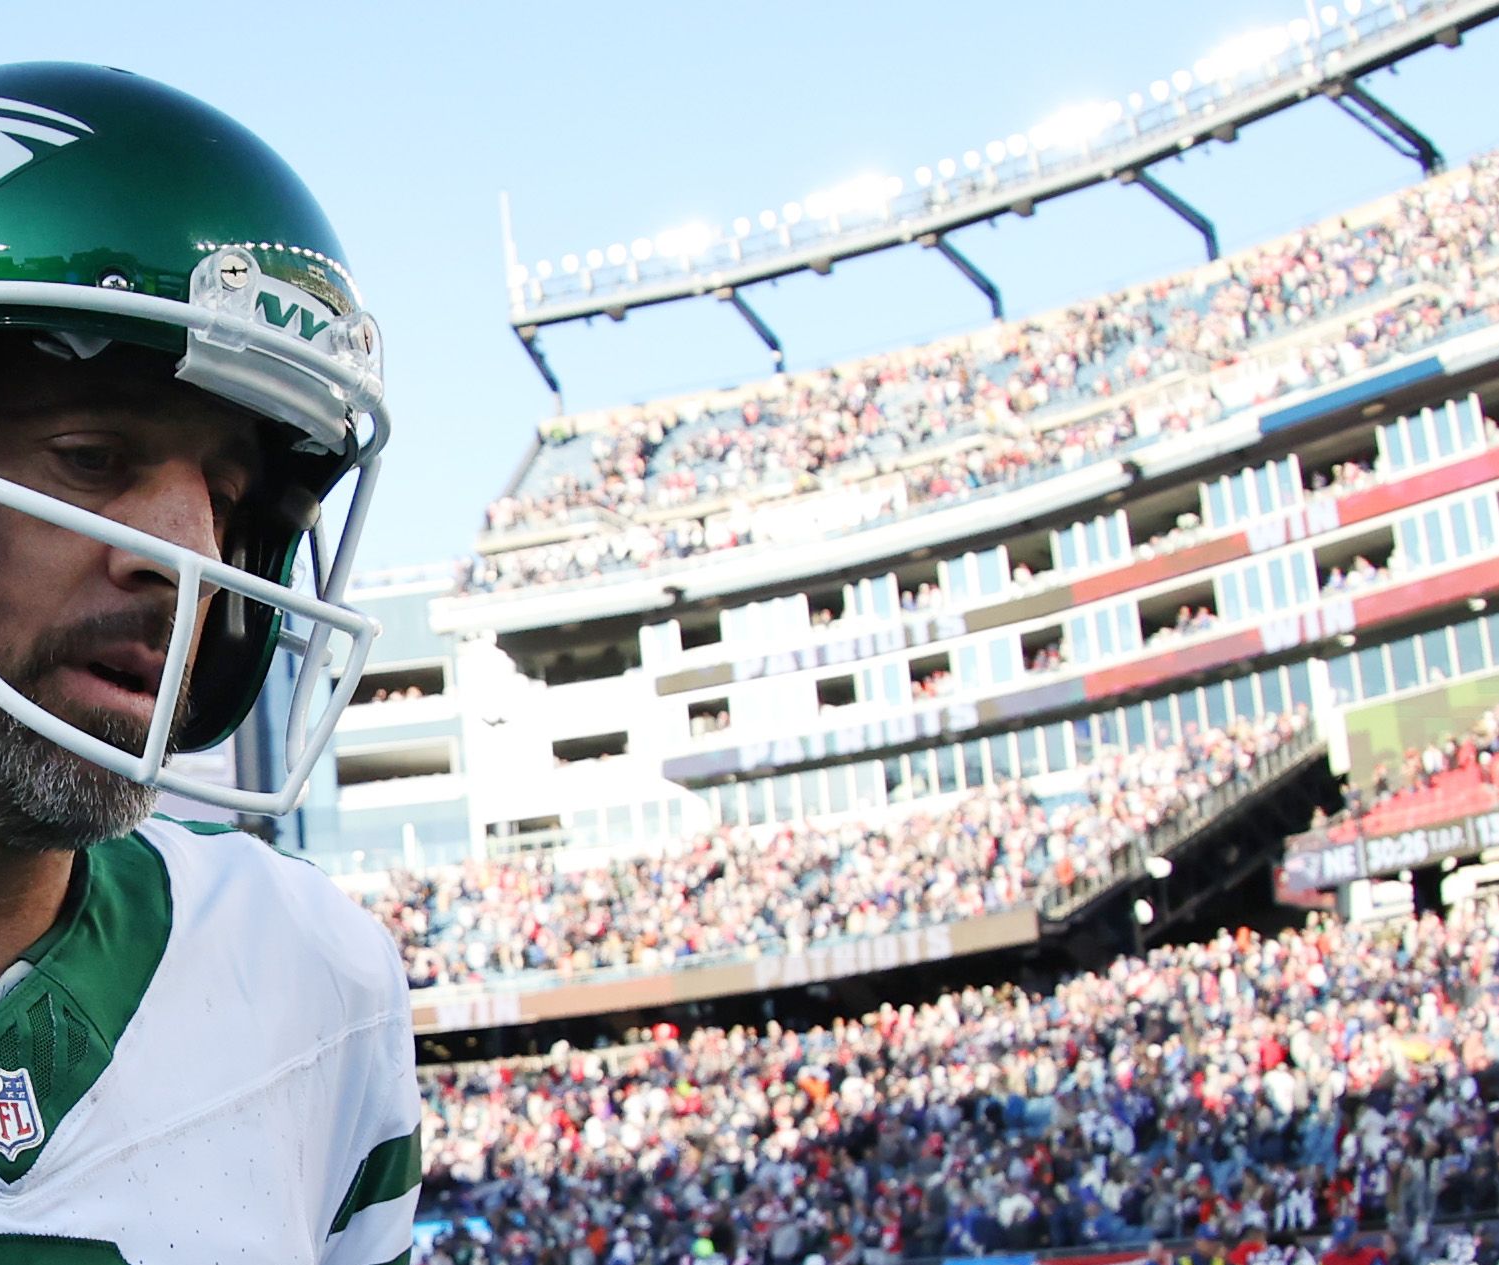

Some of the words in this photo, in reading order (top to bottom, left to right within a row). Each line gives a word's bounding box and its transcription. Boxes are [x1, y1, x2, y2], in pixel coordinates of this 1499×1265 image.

[255, 290, 331, 342] NY
[1249, 500, 1340, 554] WIN
[731, 613, 967, 682] PATRIOTS
[1262, 601, 1356, 654] WIN
[737, 703, 979, 771] PATRIOTS
[1322, 844, 1357, 879] NE
[752, 926, 953, 990] PATRIOTS
